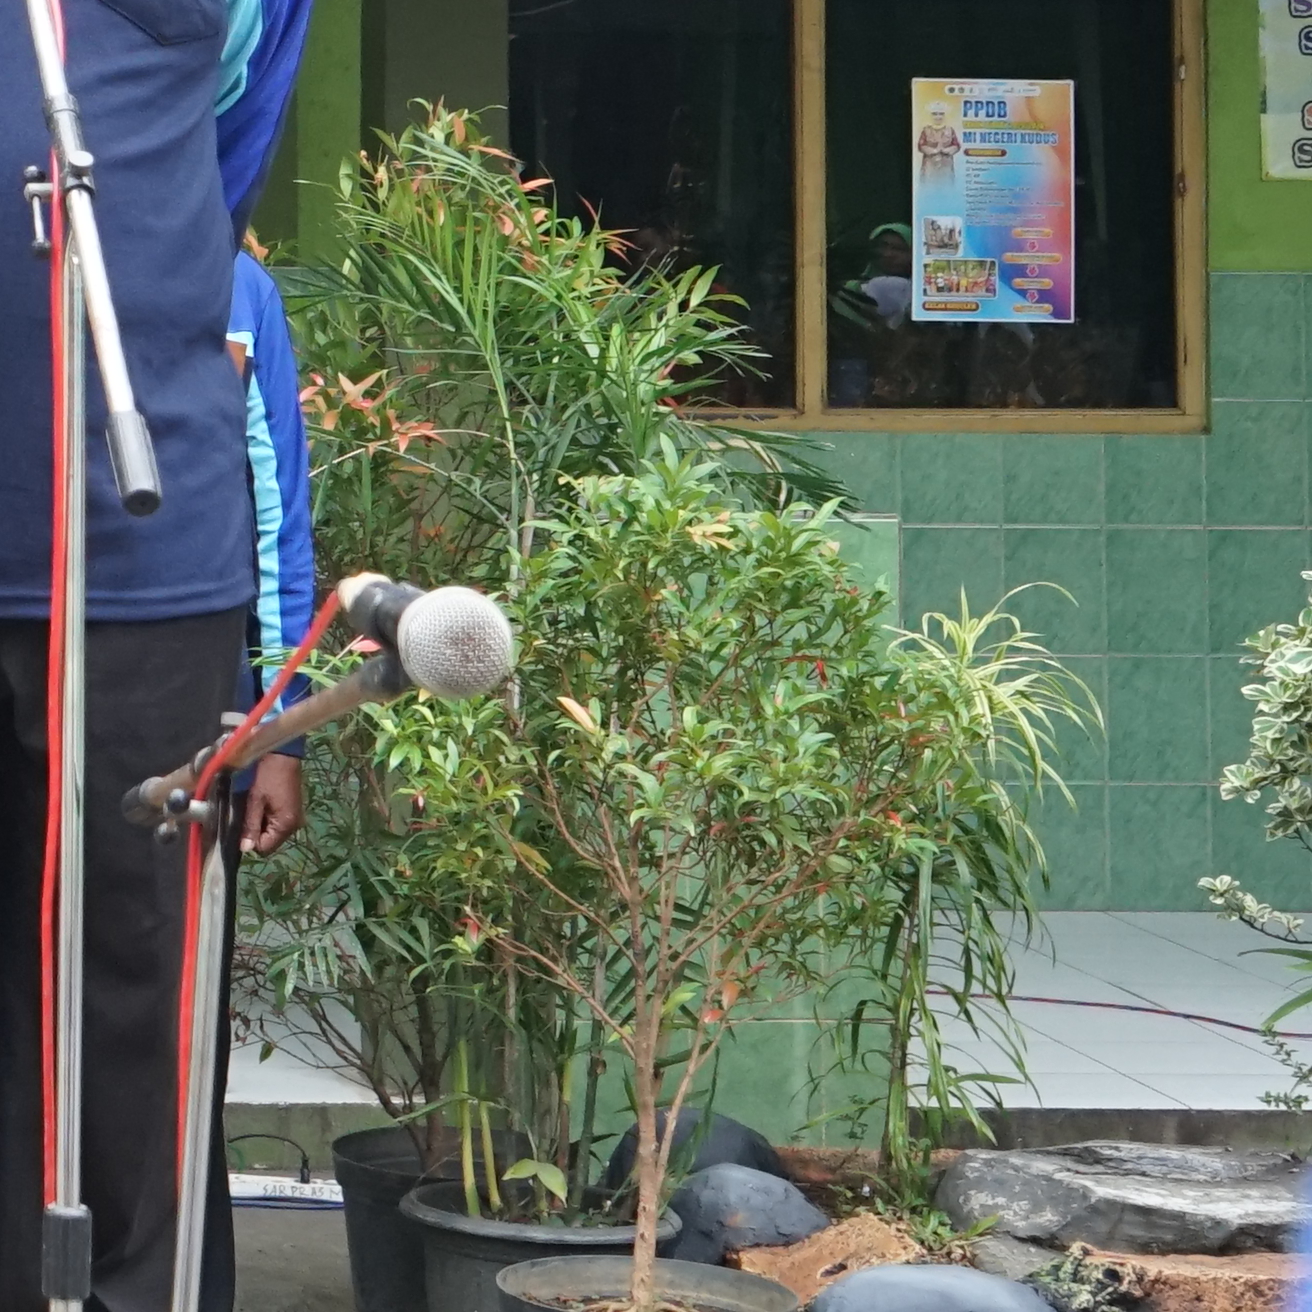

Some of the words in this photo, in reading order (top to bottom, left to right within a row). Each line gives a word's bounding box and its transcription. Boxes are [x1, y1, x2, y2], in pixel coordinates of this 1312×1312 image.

[962, 99, 1008, 119] PPDB
[962, 131, 977, 144] MI
[979, 132, 1018, 144] NEGERI
